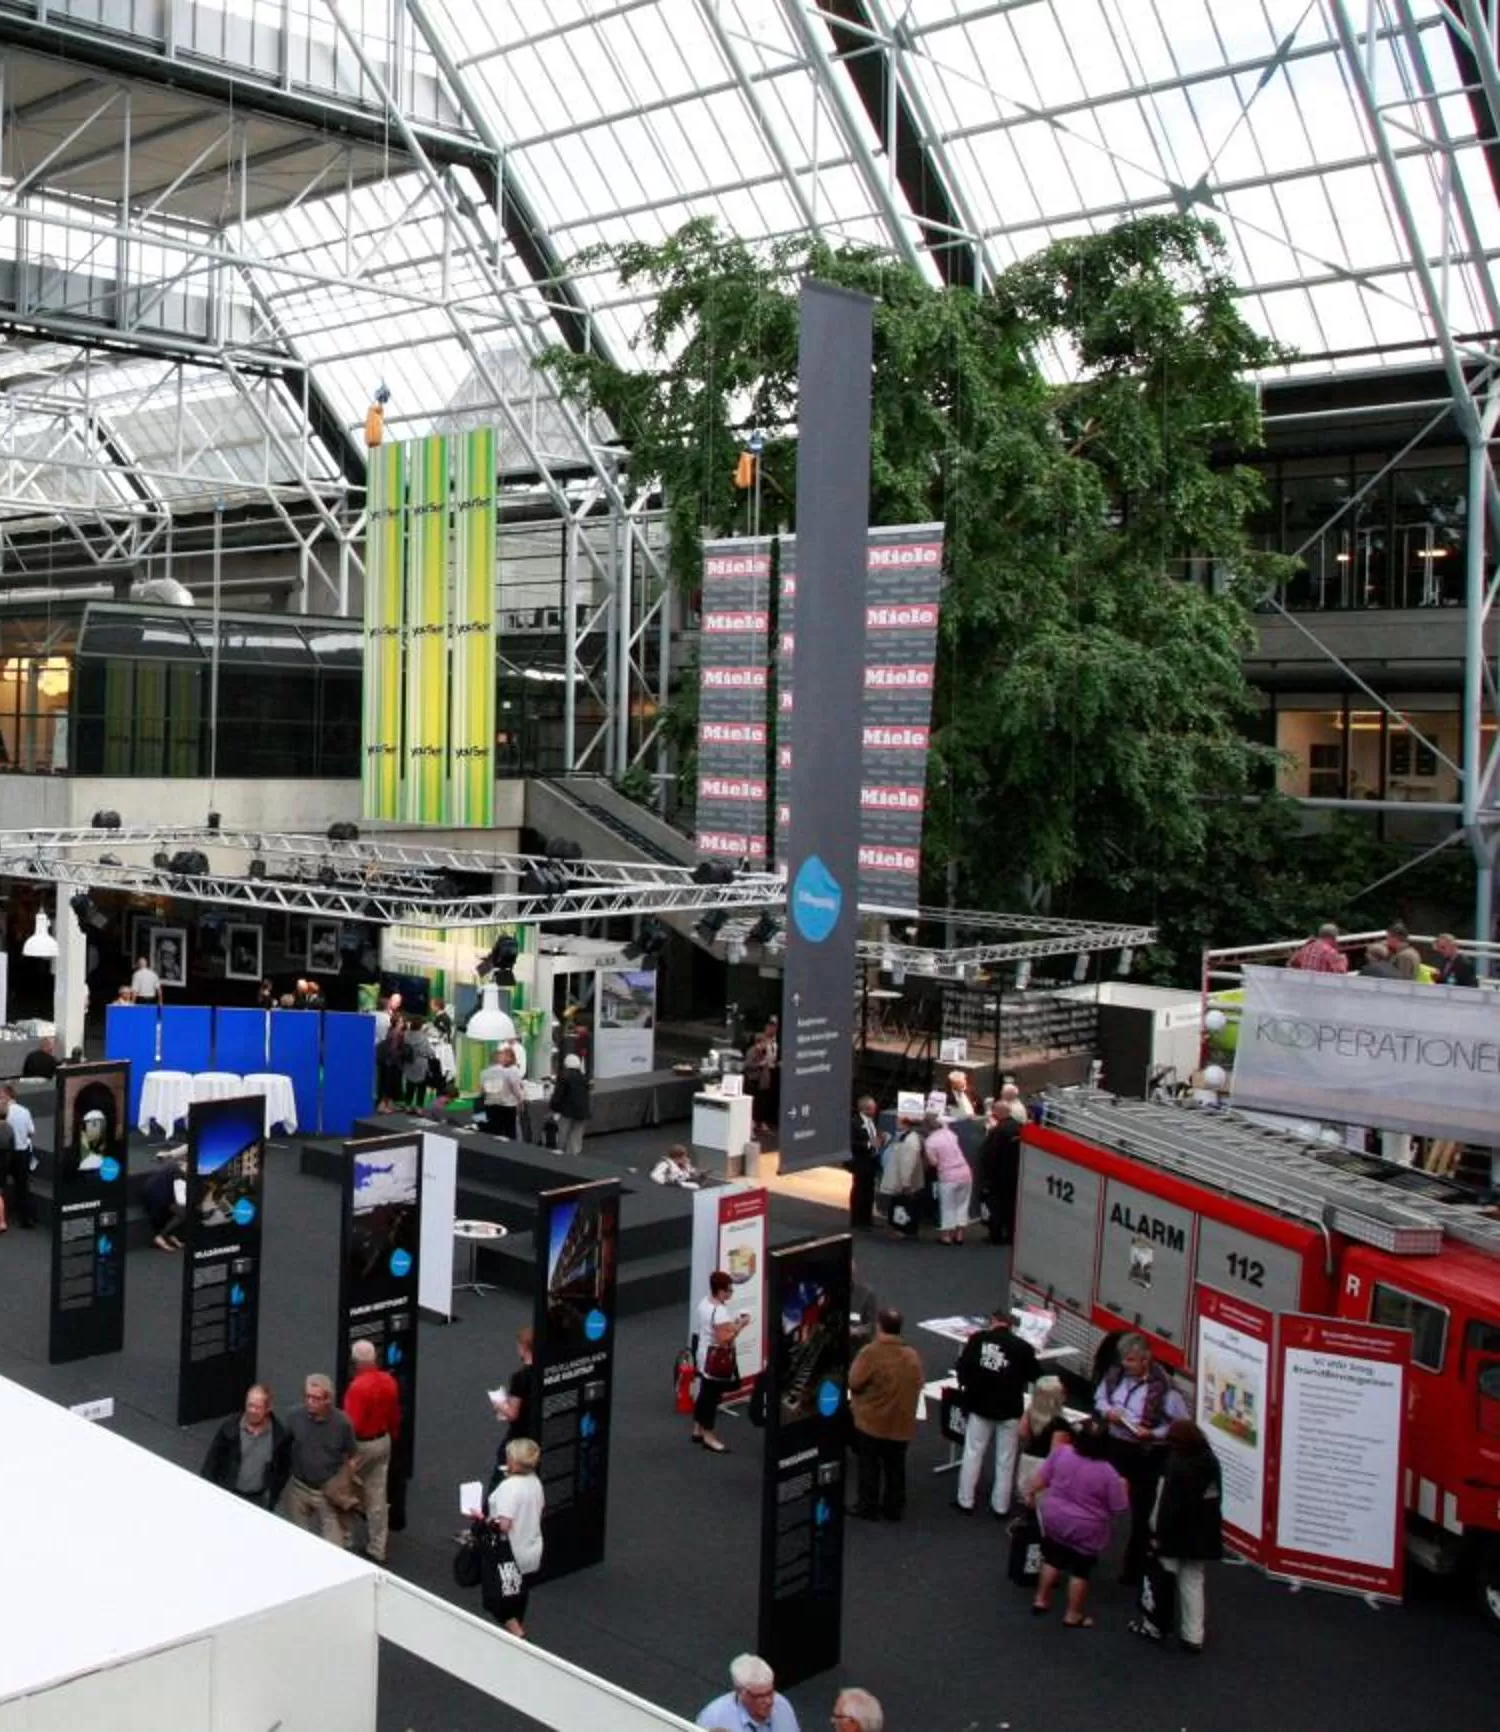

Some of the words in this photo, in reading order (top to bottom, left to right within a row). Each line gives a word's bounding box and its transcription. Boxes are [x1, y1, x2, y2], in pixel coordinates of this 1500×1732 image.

[870, 548, 937, 565] Miele
[707, 560, 767, 574] Miele
[706, 615, 765, 630] Miele
[868, 609, 933, 625] Miele
[704, 671, 764, 686] Miele
[865, 669, 928, 685] Miele
[703, 726, 763, 741] Miele
[864, 729, 924, 746] Miele
[702, 781, 762, 796] Miele
[861, 790, 920, 806] Miele
[701, 836, 762, 852] Miele
[859, 850, 916, 867] Miele
[1256, 1015, 1500, 1073] KOOPERATIONE
[1046, 1175, 1075, 1205] 112
[1110, 1203, 1186, 1252] ALARM
[1226, 1252, 1266, 1288] 112
[1346, 1274, 1359, 1297] R
